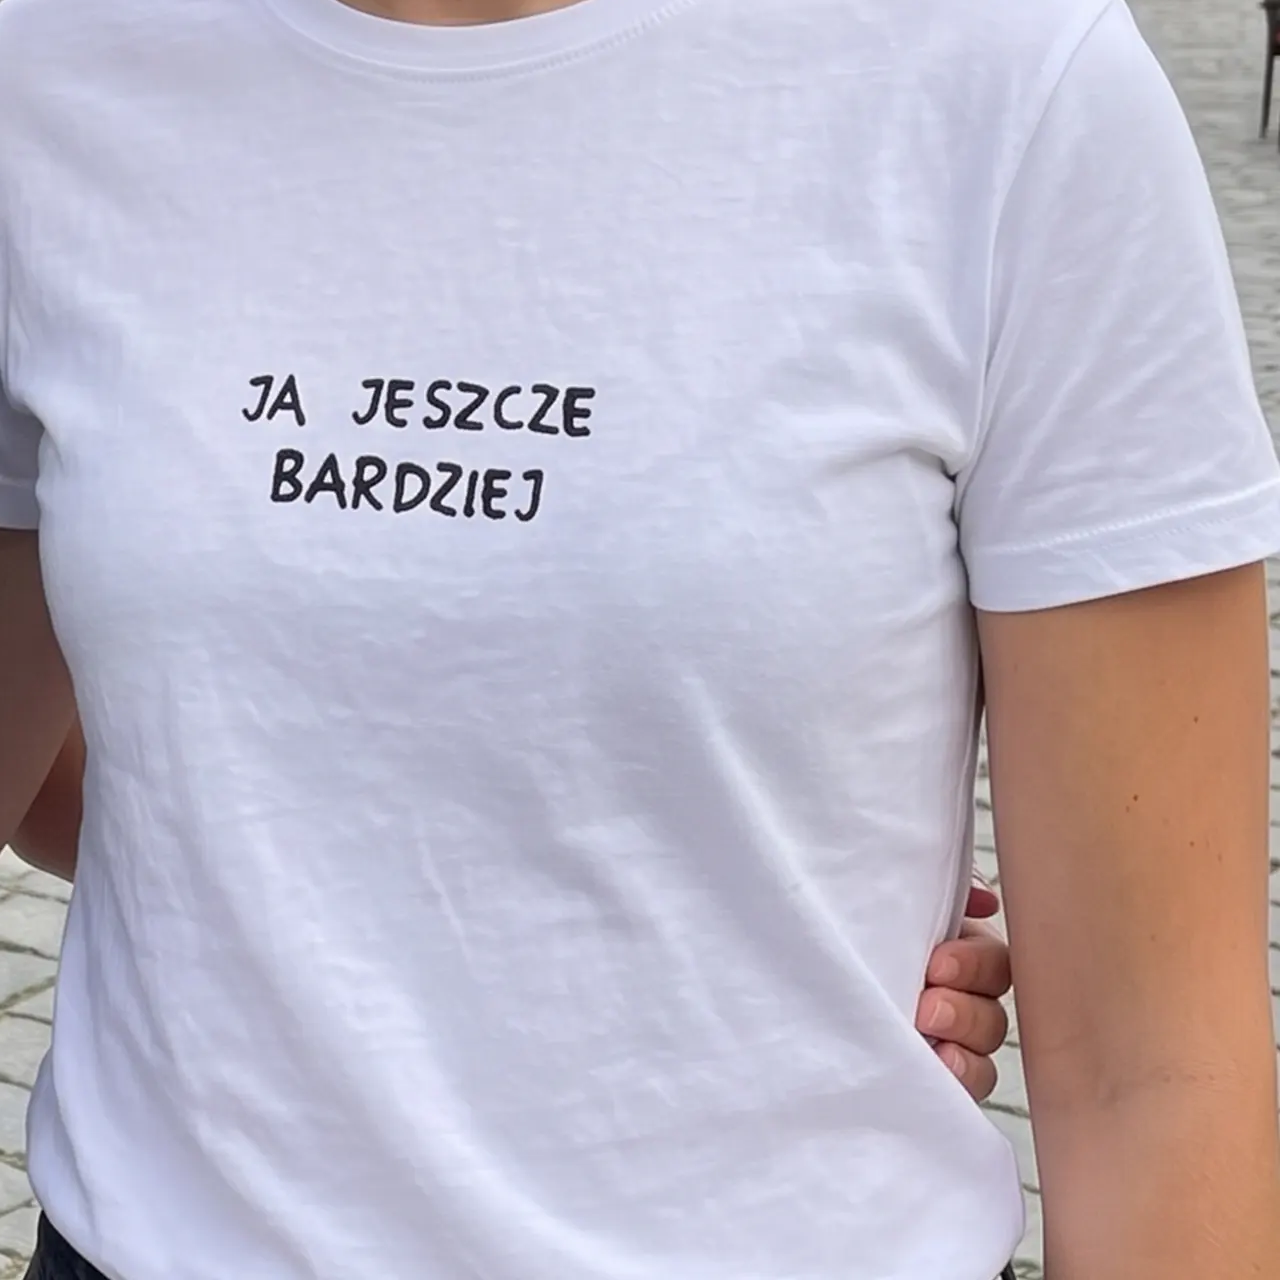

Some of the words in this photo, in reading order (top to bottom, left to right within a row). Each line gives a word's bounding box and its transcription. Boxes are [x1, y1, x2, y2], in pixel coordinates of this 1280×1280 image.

[241, 373, 307, 428] JA
[351, 377, 597, 439] JESZCZE
[269, 447, 545, 523] BARDZIEJ
